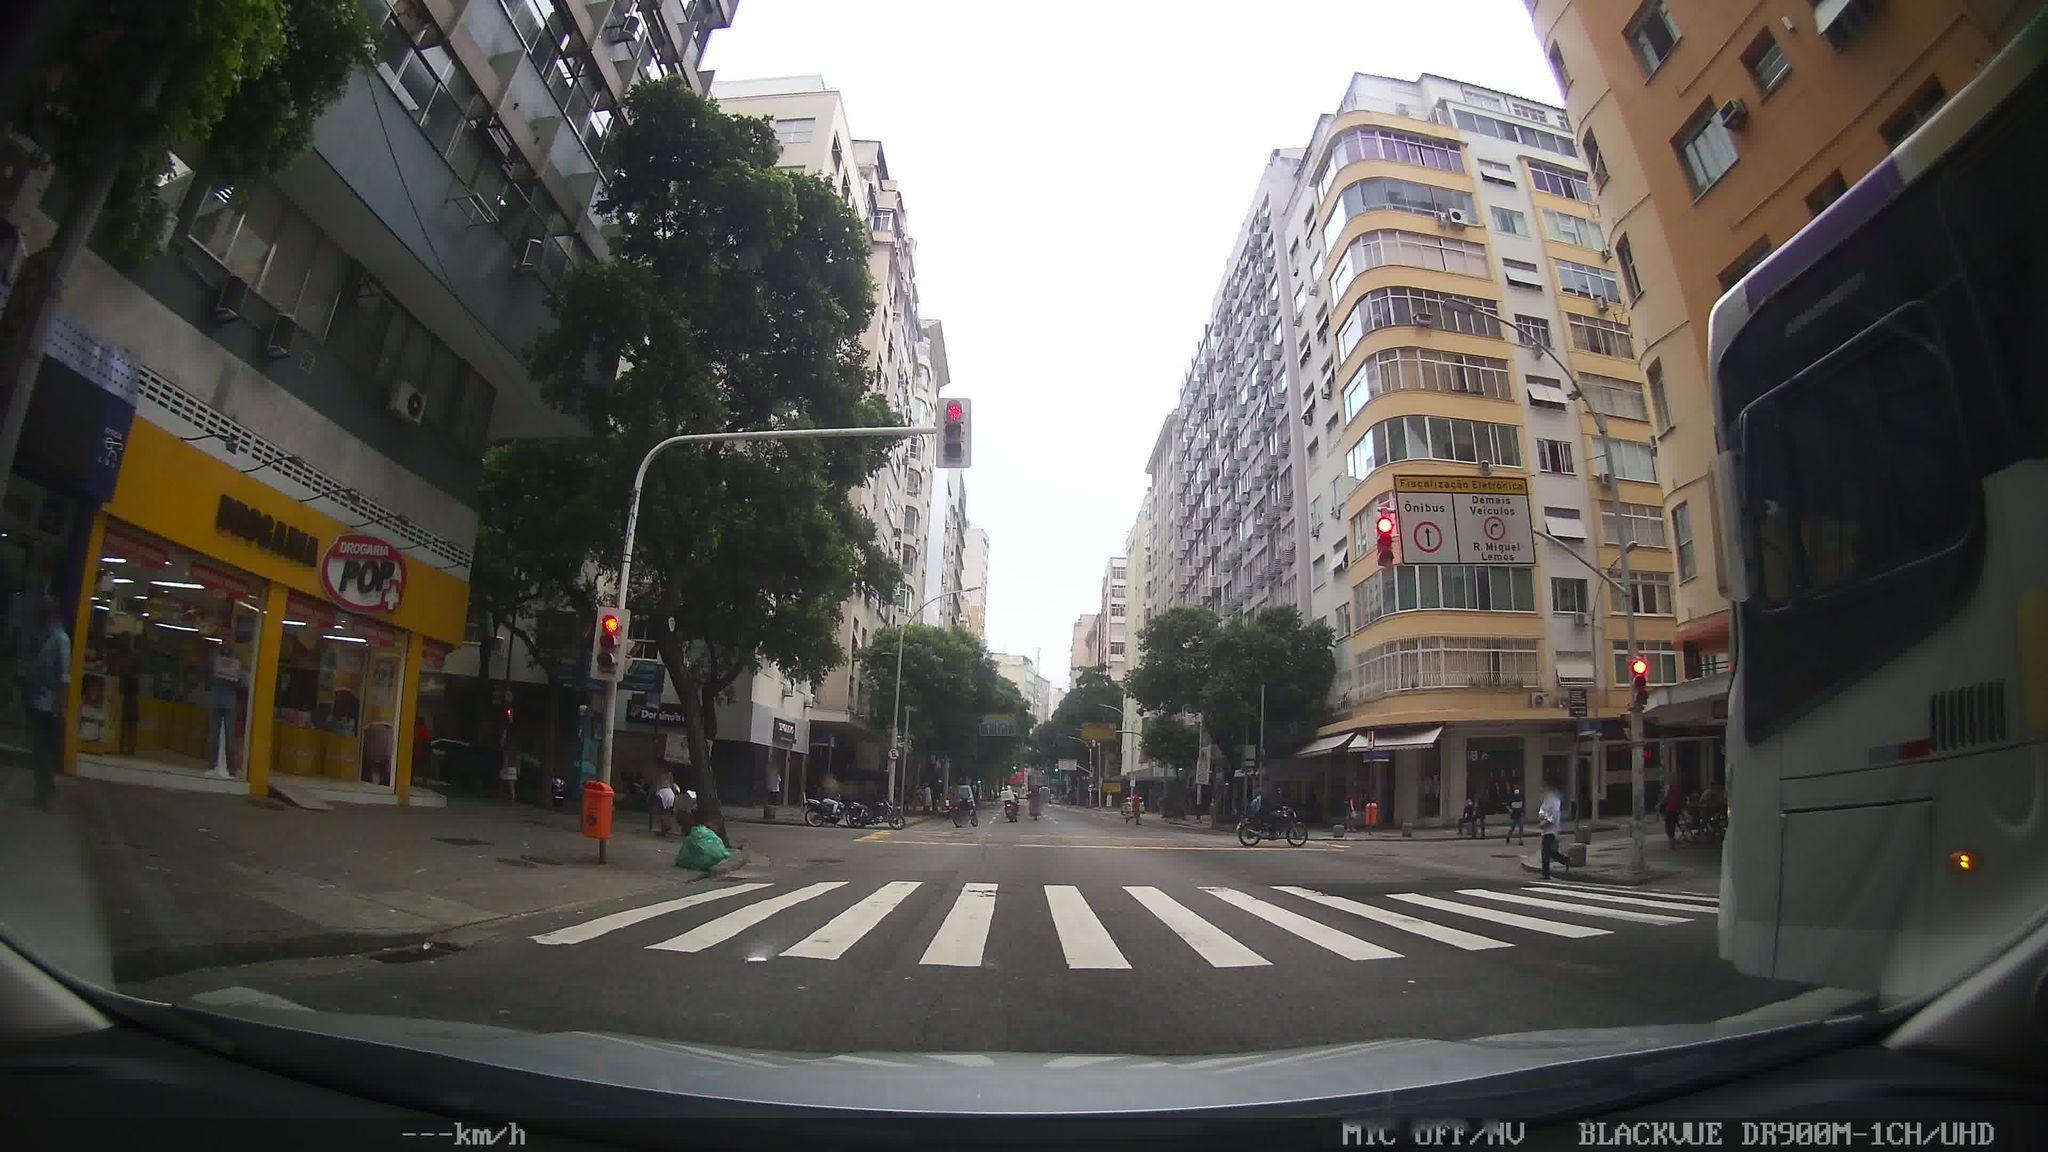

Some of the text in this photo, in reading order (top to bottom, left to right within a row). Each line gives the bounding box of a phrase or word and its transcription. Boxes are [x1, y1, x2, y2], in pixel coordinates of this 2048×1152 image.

[1400, 479, 1524, 491] Fiscalização Eletrônica
[1472, 495, 1511, 504] Demais
[1404, 500, 1446, 513] Ônibus
[1469, 505, 1516, 515] Veículos
[340, 541, 389, 557] DROGARIA
[1473, 542, 1520, 553] R. Miguel
[1481, 552, 1515, 560] Lemos
[338, 560, 396, 594] POP
